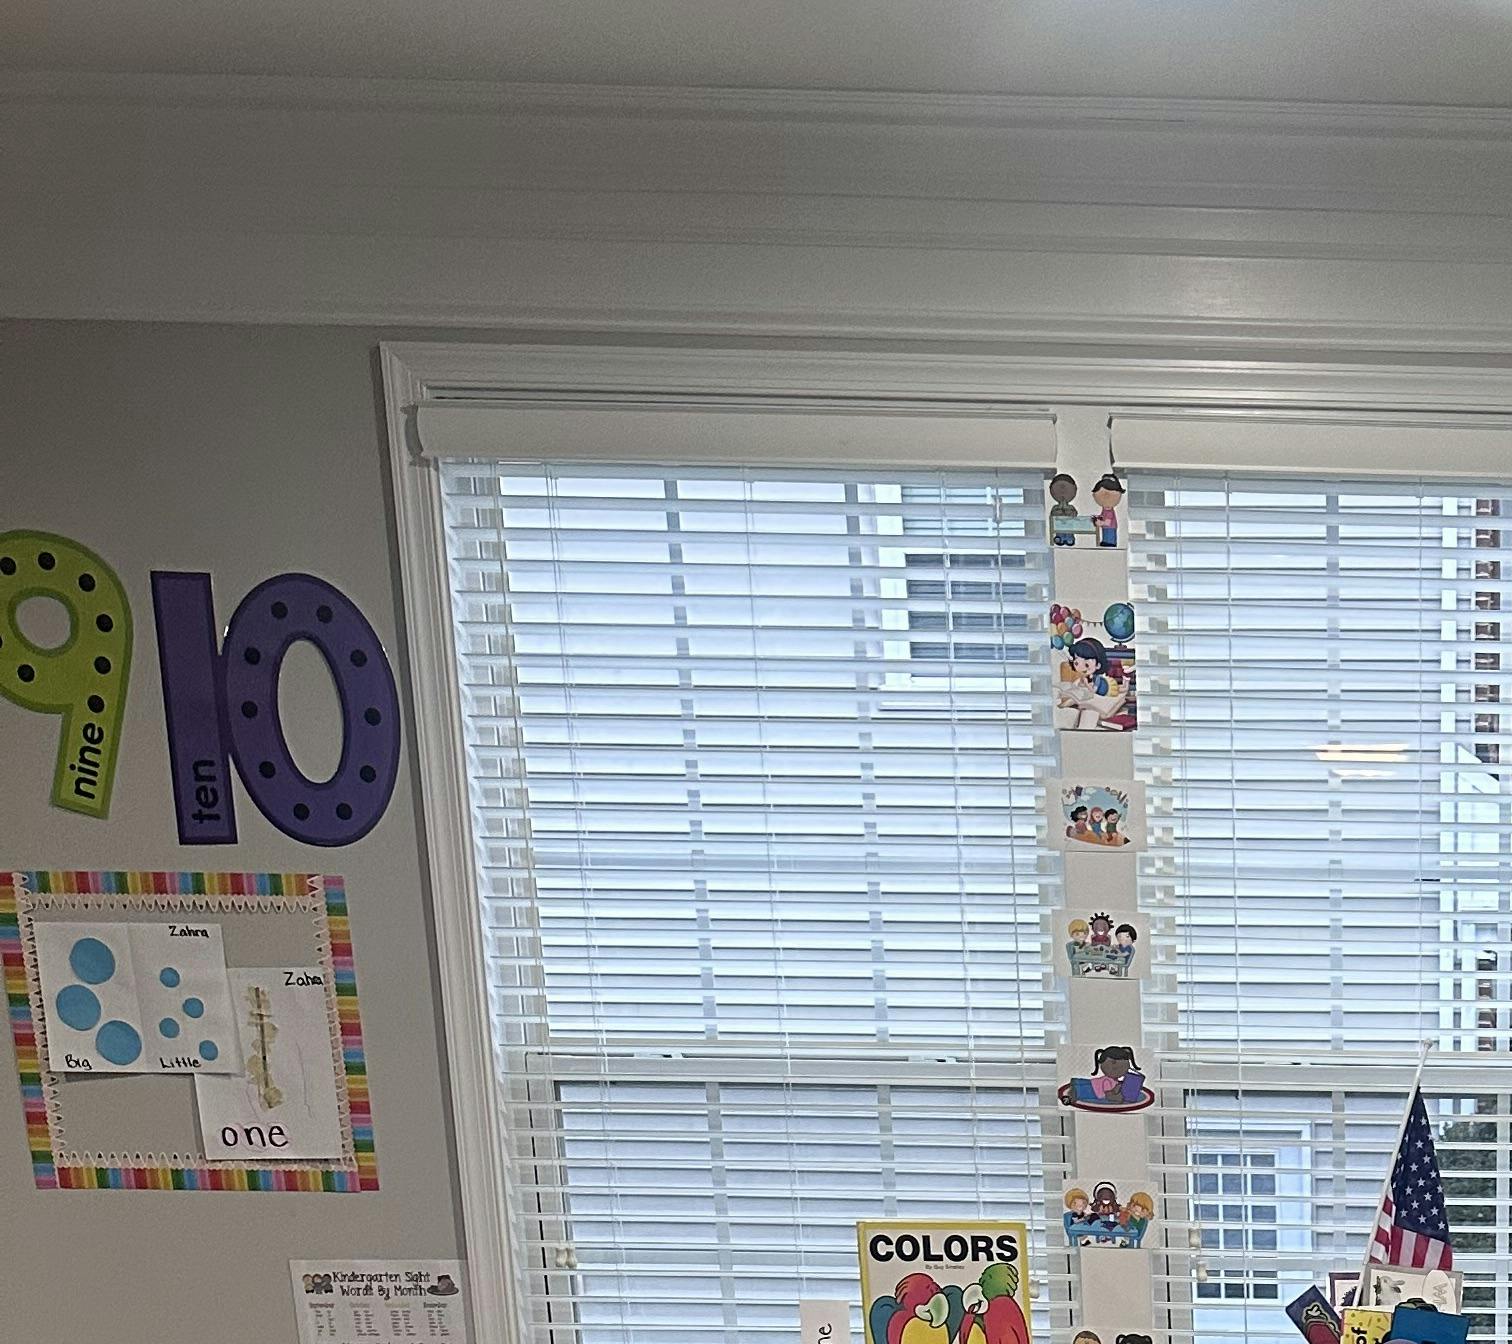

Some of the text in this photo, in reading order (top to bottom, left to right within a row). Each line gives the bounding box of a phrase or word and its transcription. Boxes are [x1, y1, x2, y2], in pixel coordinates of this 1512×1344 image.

[150, 570, 401, 847] 10
[73, 721, 104, 798] nine
[192, 758, 223, 825] ten
[64, 1053, 92, 1071] Big
[159, 1056, 201, 1069] Little
[221, 1123, 289, 1149] one
[869, 1234, 1018, 1262] COLORS
[332, 1272, 400, 1286] Kindergarten
[378, 1285, 390, 1300] By
[394, 1285, 427, 1296] Month
